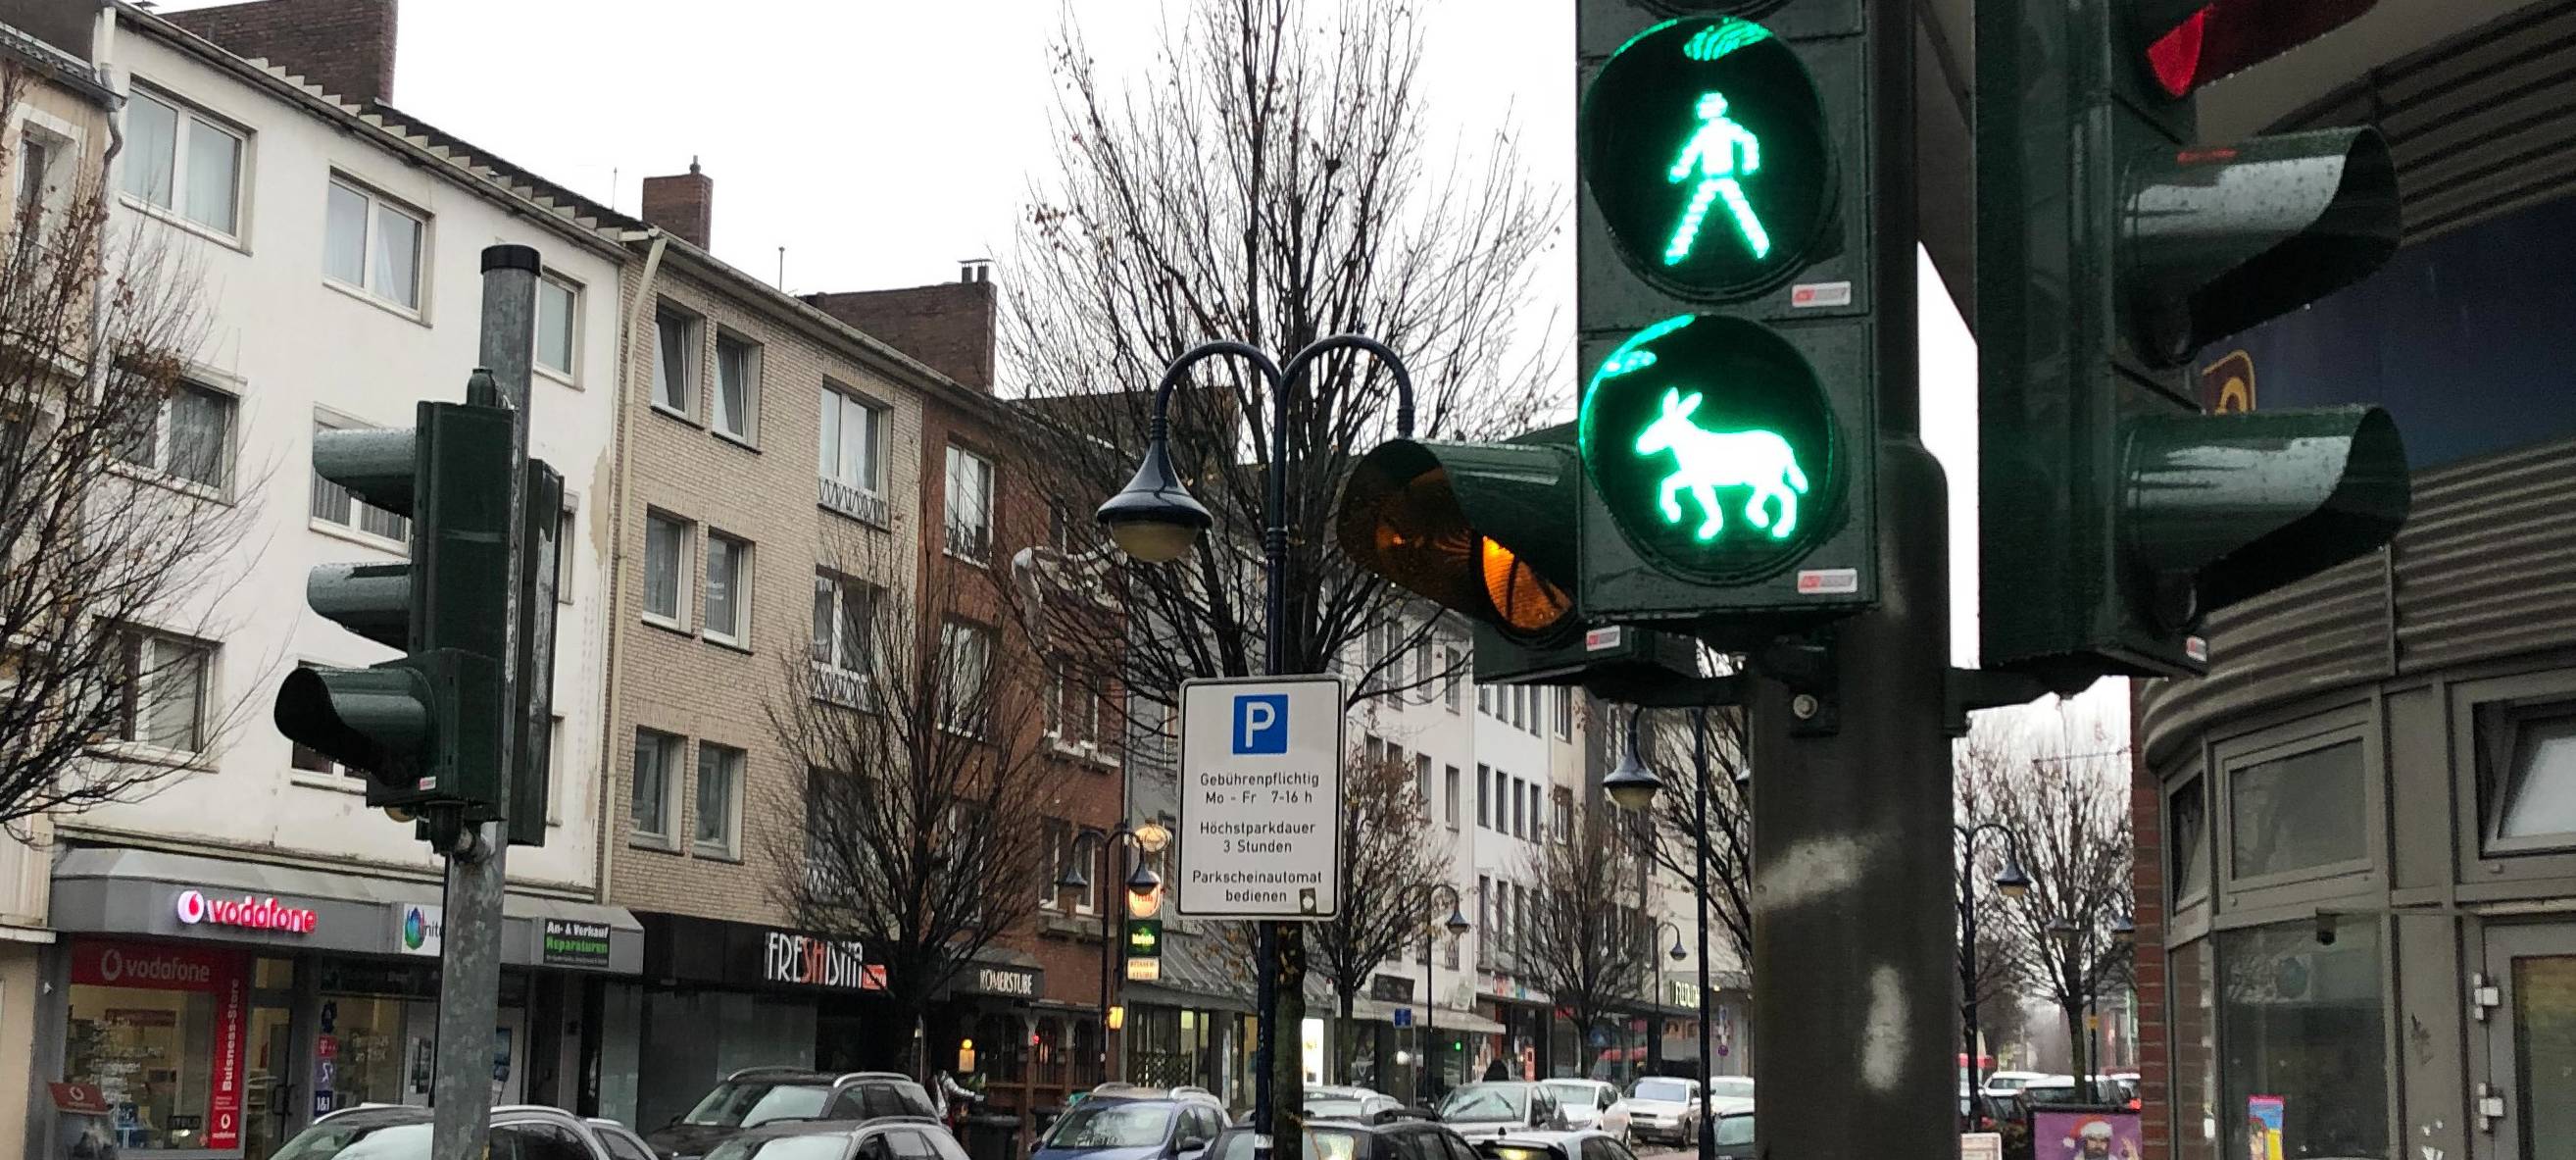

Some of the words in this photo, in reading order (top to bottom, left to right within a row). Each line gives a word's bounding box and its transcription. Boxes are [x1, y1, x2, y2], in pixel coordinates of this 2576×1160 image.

[1245, 702, 1275, 748] P
[1200, 772, 1319, 788] Gebührenpflichtig
[1206, 790, 1224, 804] Mo
[1242, 789, 1257, 804] Fr
[1270, 789, 1299, 803] 7-16
[1305, 789, 1313, 804] h
[1200, 821, 1315, 837] Höchstparkdauer
[1223, 839, 1231, 853] 3
[1237, 838, 1292, 853] Stunden
[1192, 869, 1321, 884] Parkscheinautomat
[1225, 888, 1287, 903] bedienen
[207, 896, 318, 934] vodafone
[125, 957, 210, 982] vodafone
